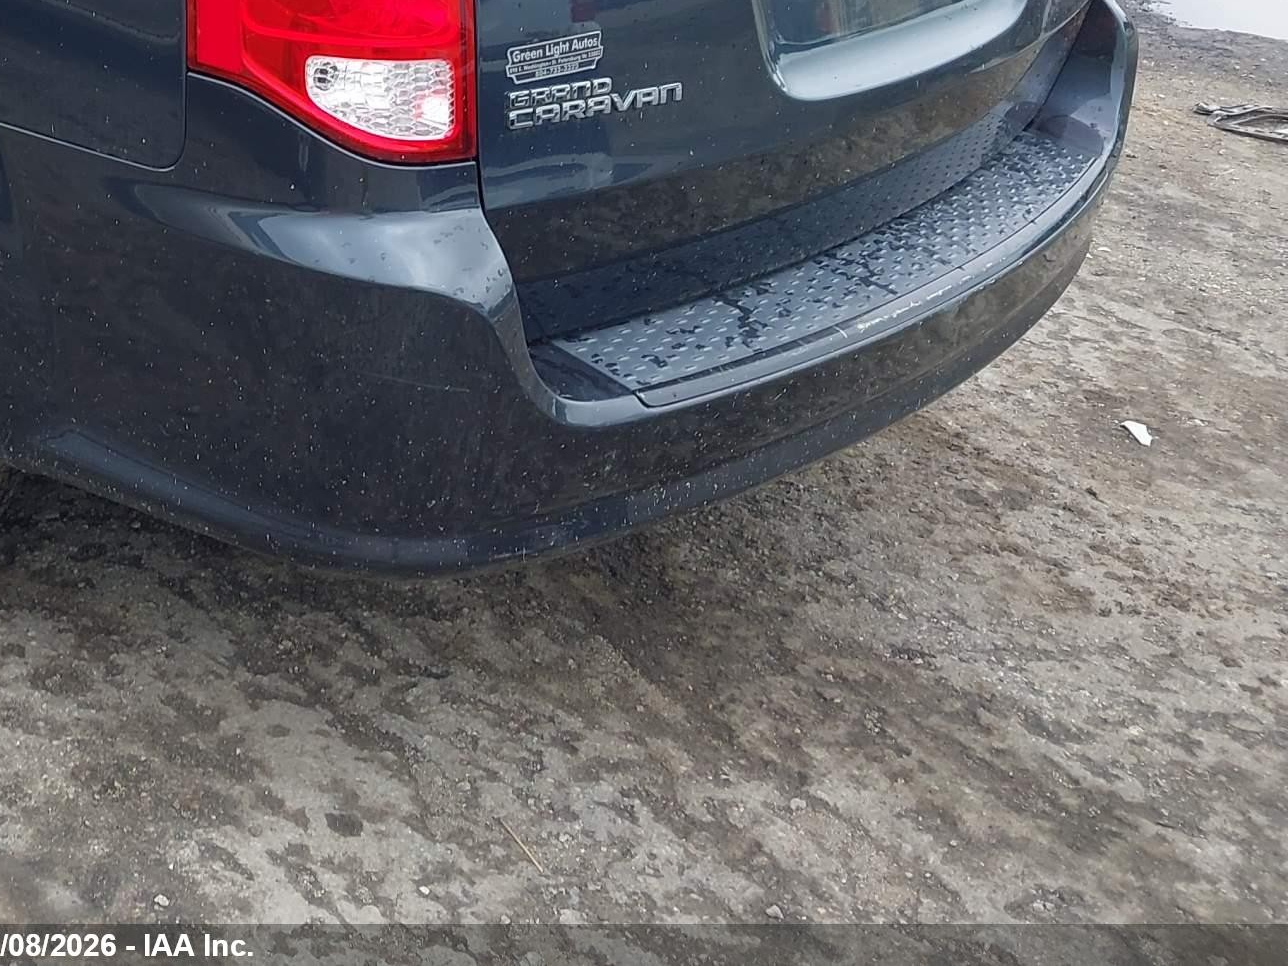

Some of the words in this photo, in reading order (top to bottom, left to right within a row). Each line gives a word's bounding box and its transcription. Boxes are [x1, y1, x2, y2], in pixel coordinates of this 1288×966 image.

[512, 49, 543, 63] Green
[545, 41, 570, 58] Light
[571, 37, 598, 51] Autos
[508, 82, 683, 130] CARAVAN
[509, 77, 613, 108] GRAND
